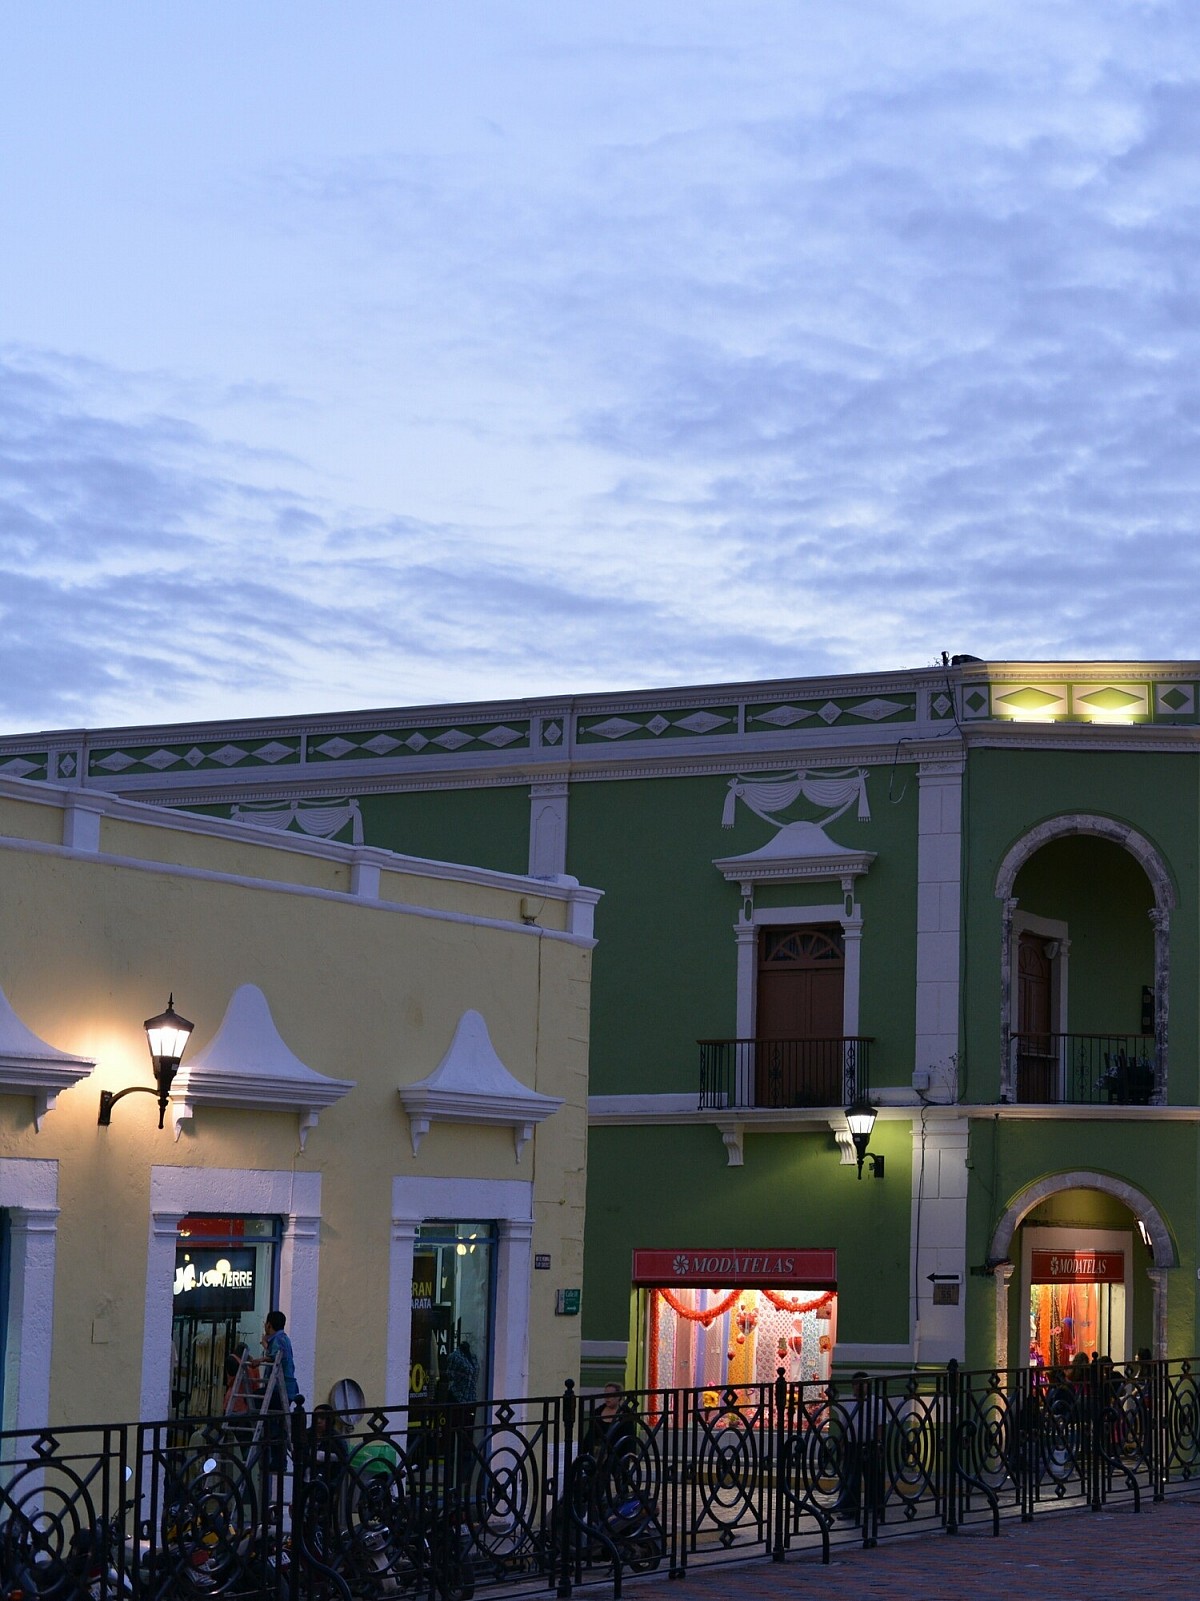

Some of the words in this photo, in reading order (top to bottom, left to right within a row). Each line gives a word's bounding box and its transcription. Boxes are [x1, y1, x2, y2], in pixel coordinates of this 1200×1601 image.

[691, 1258, 795, 1273] MODATELAS
[1059, 1258, 1107, 1274] MODATELAS
[196, 1271, 253, 1288] JOA/ERRE
[414, 1281, 433, 1297] RAN
